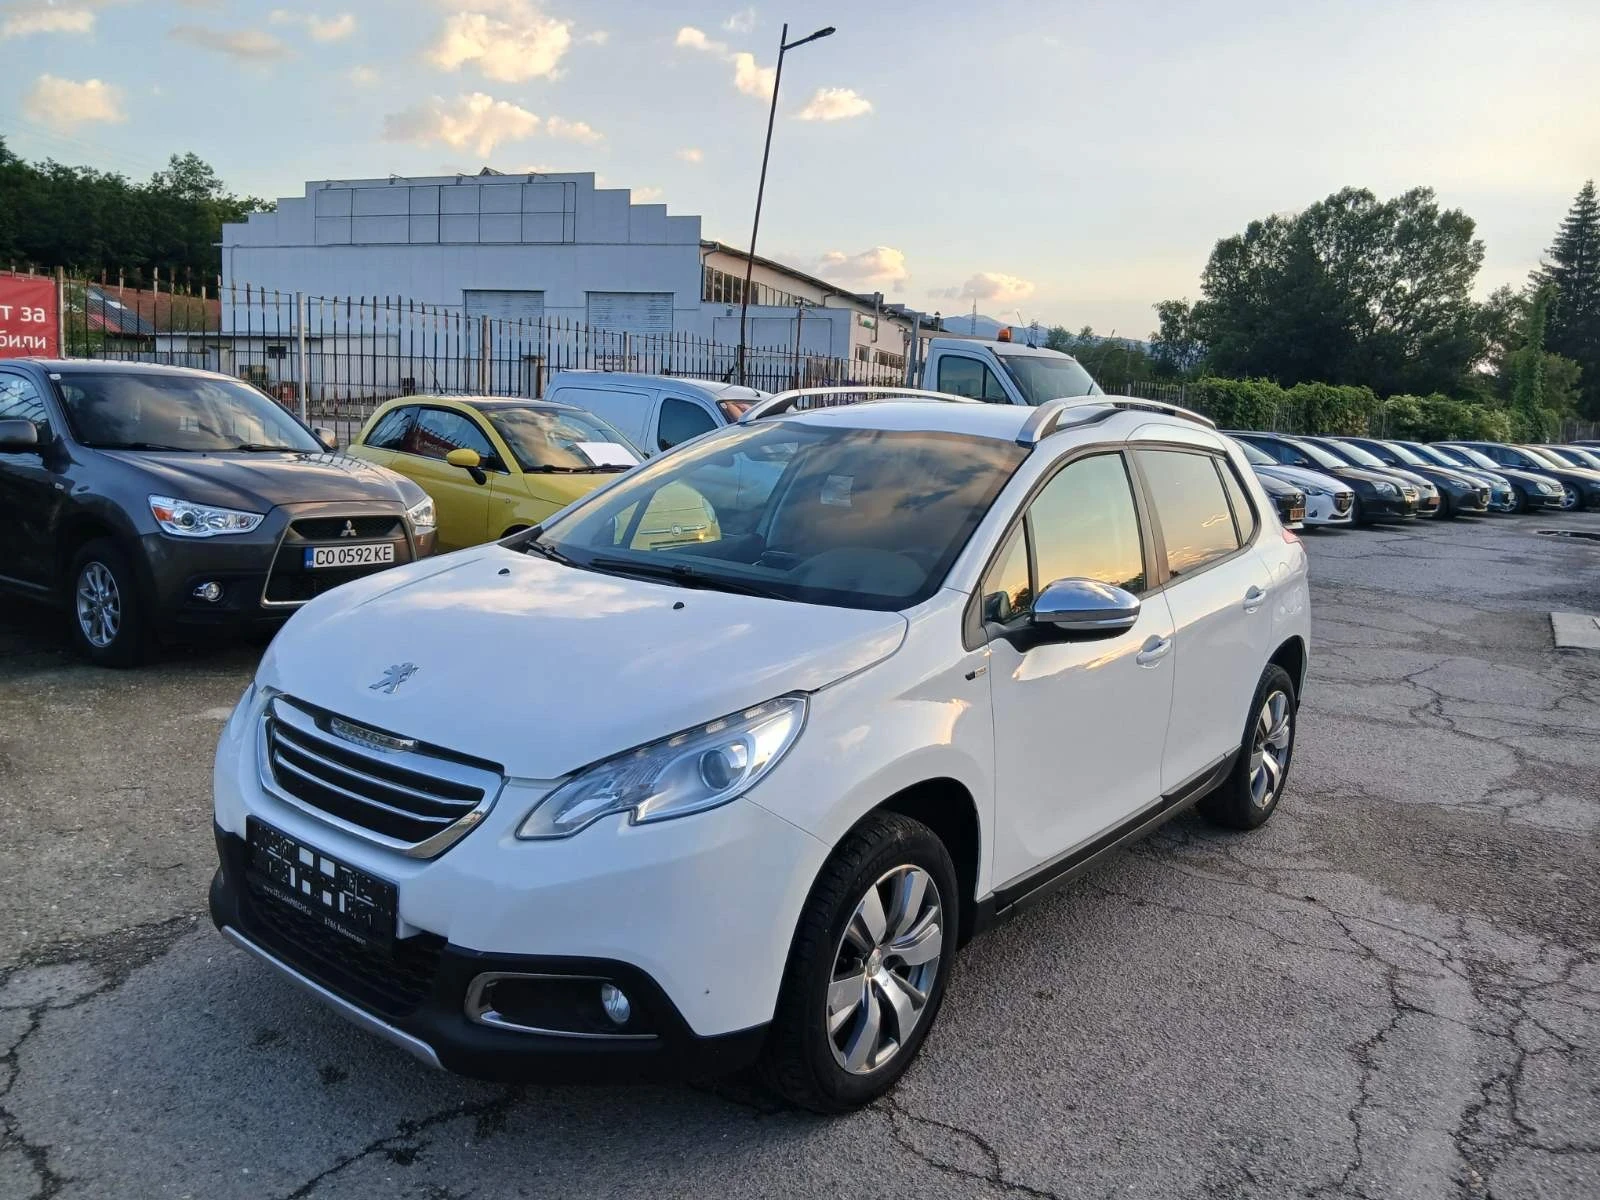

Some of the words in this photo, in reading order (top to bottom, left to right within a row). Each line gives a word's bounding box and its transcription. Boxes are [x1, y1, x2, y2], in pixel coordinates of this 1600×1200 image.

[20, 306, 46, 323] за
[315, 550, 335, 565] CO
[338, 548, 372, 564] 0592
[374, 546, 392, 561] KE
